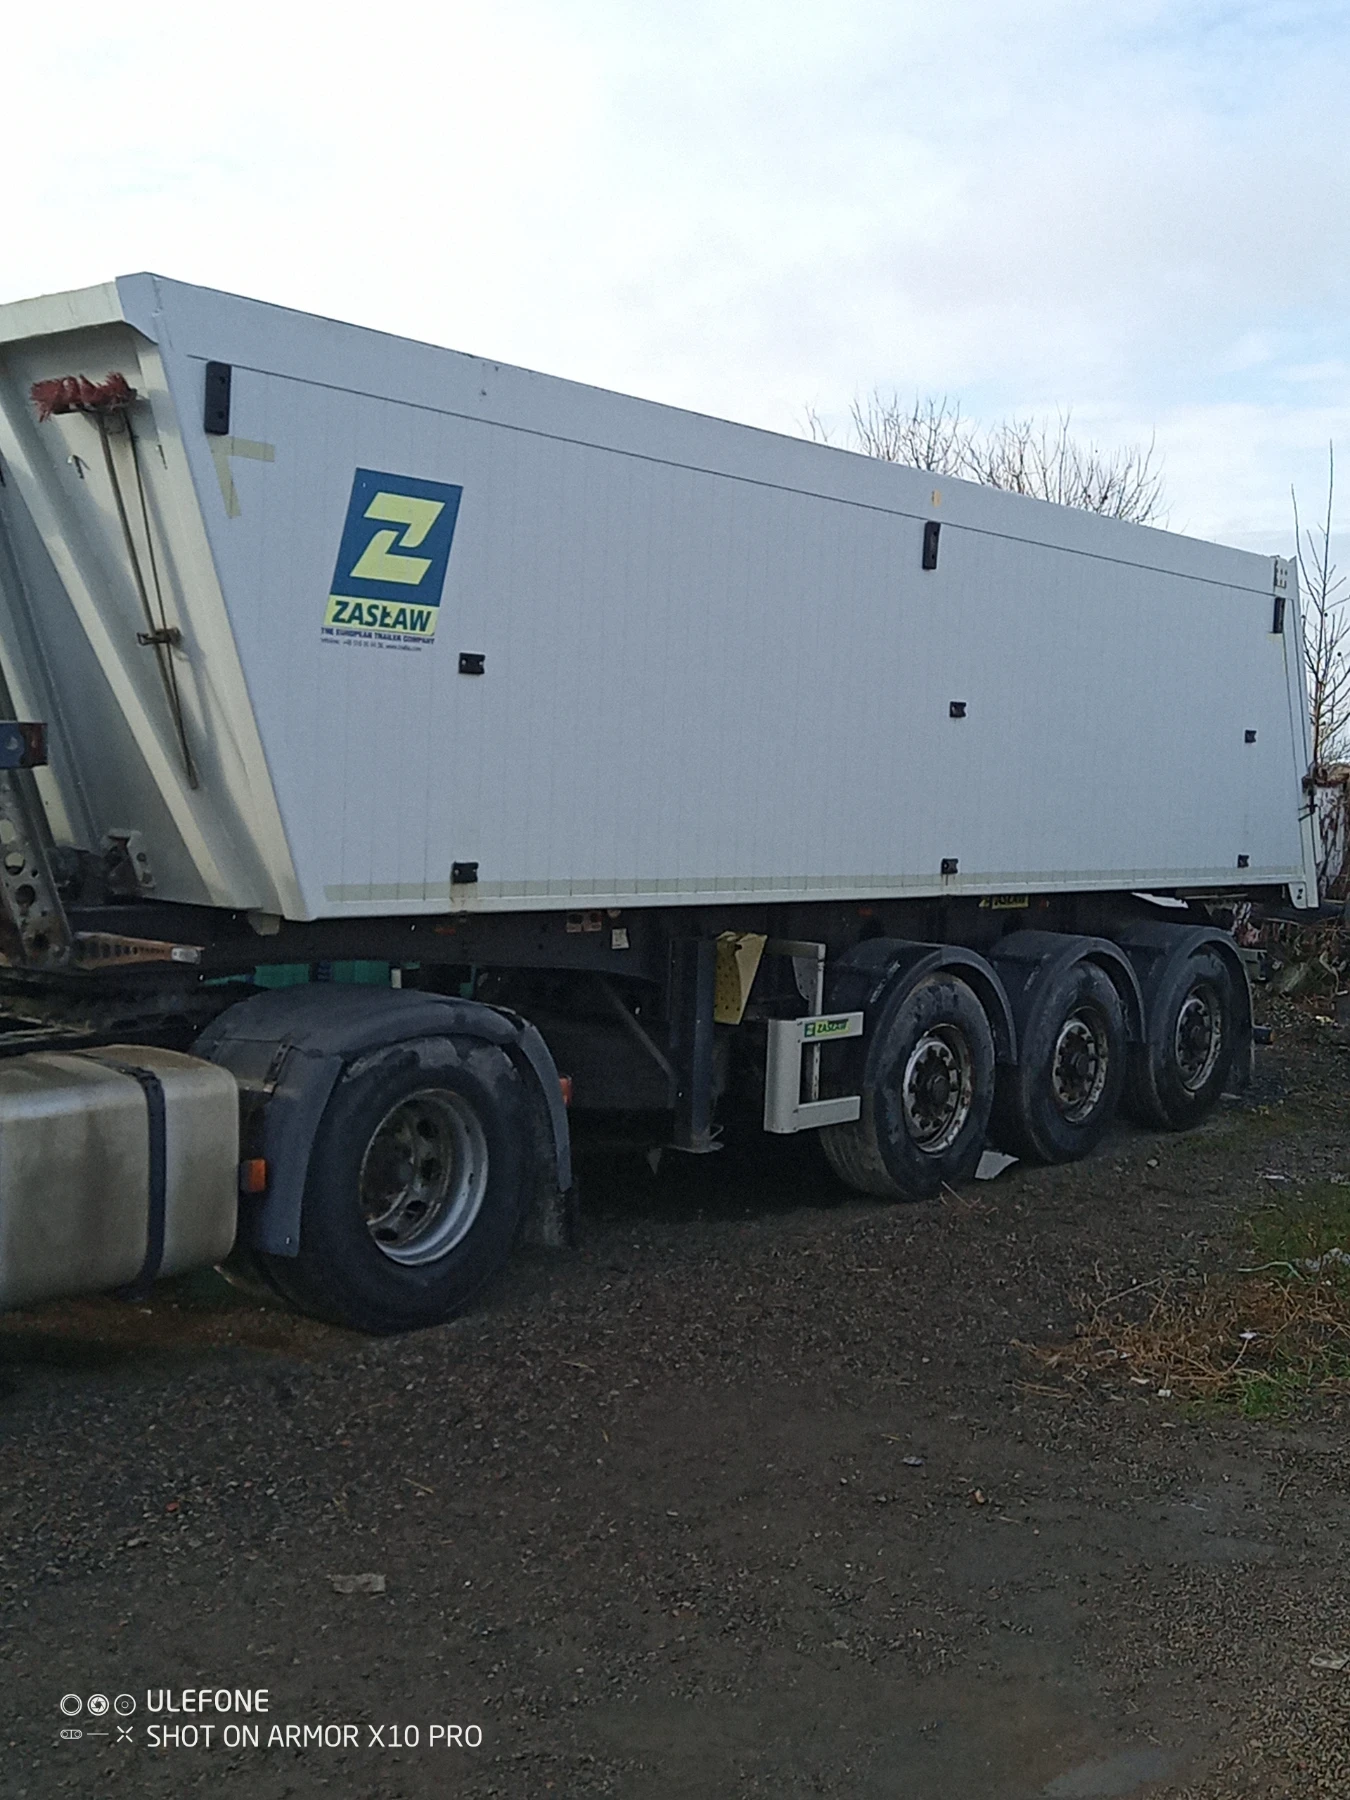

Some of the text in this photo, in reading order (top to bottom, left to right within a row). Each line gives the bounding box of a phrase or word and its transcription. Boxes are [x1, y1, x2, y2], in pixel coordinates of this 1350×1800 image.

[331, 600, 433, 633] ZASŁAW
[321, 627, 334, 636] THE
[336, 629, 373, 639] EUROPEAN
[374, 632, 402, 642] TRAILER
[403, 635, 435, 645] COMPANY
